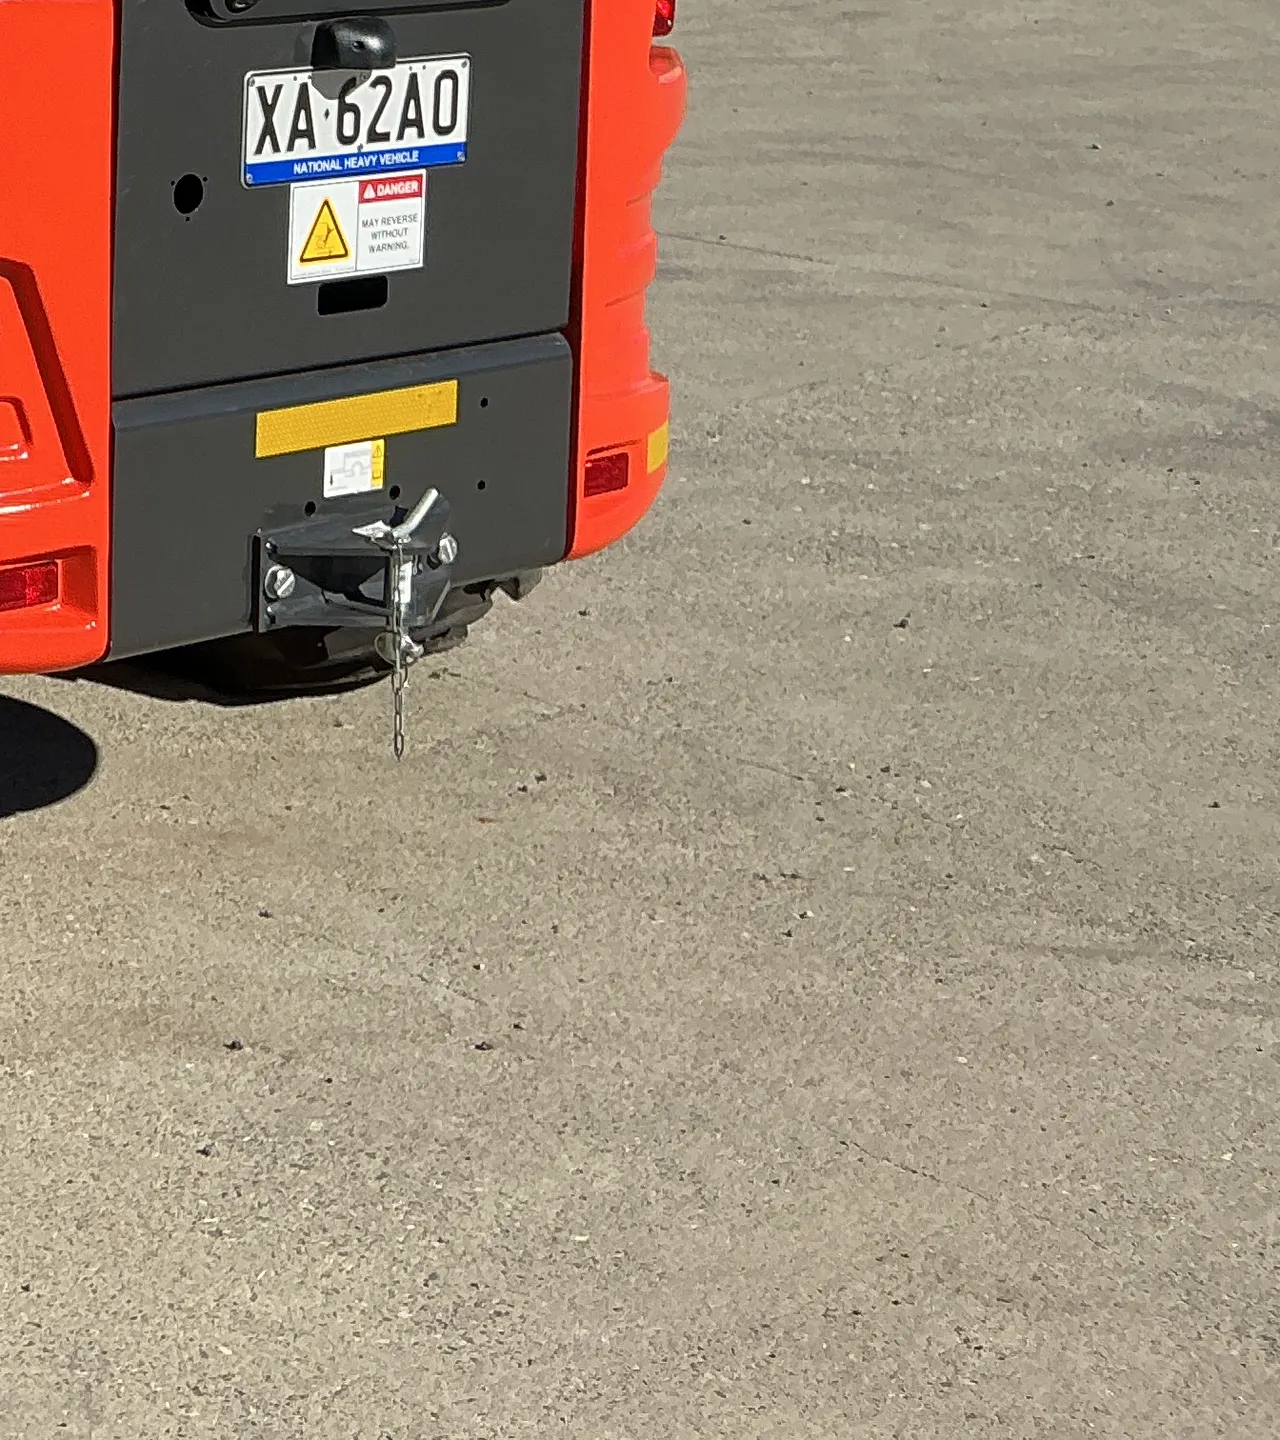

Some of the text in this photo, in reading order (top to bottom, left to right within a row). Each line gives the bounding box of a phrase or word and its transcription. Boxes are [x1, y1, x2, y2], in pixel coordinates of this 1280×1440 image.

[293, 150, 419, 174] NATIONAL HEAVY VEHICLE
[376, 181, 419, 197] DANGER
[362, 213, 418, 228] MAY REVERSE
[371, 227, 408, 240] WITHOUT
